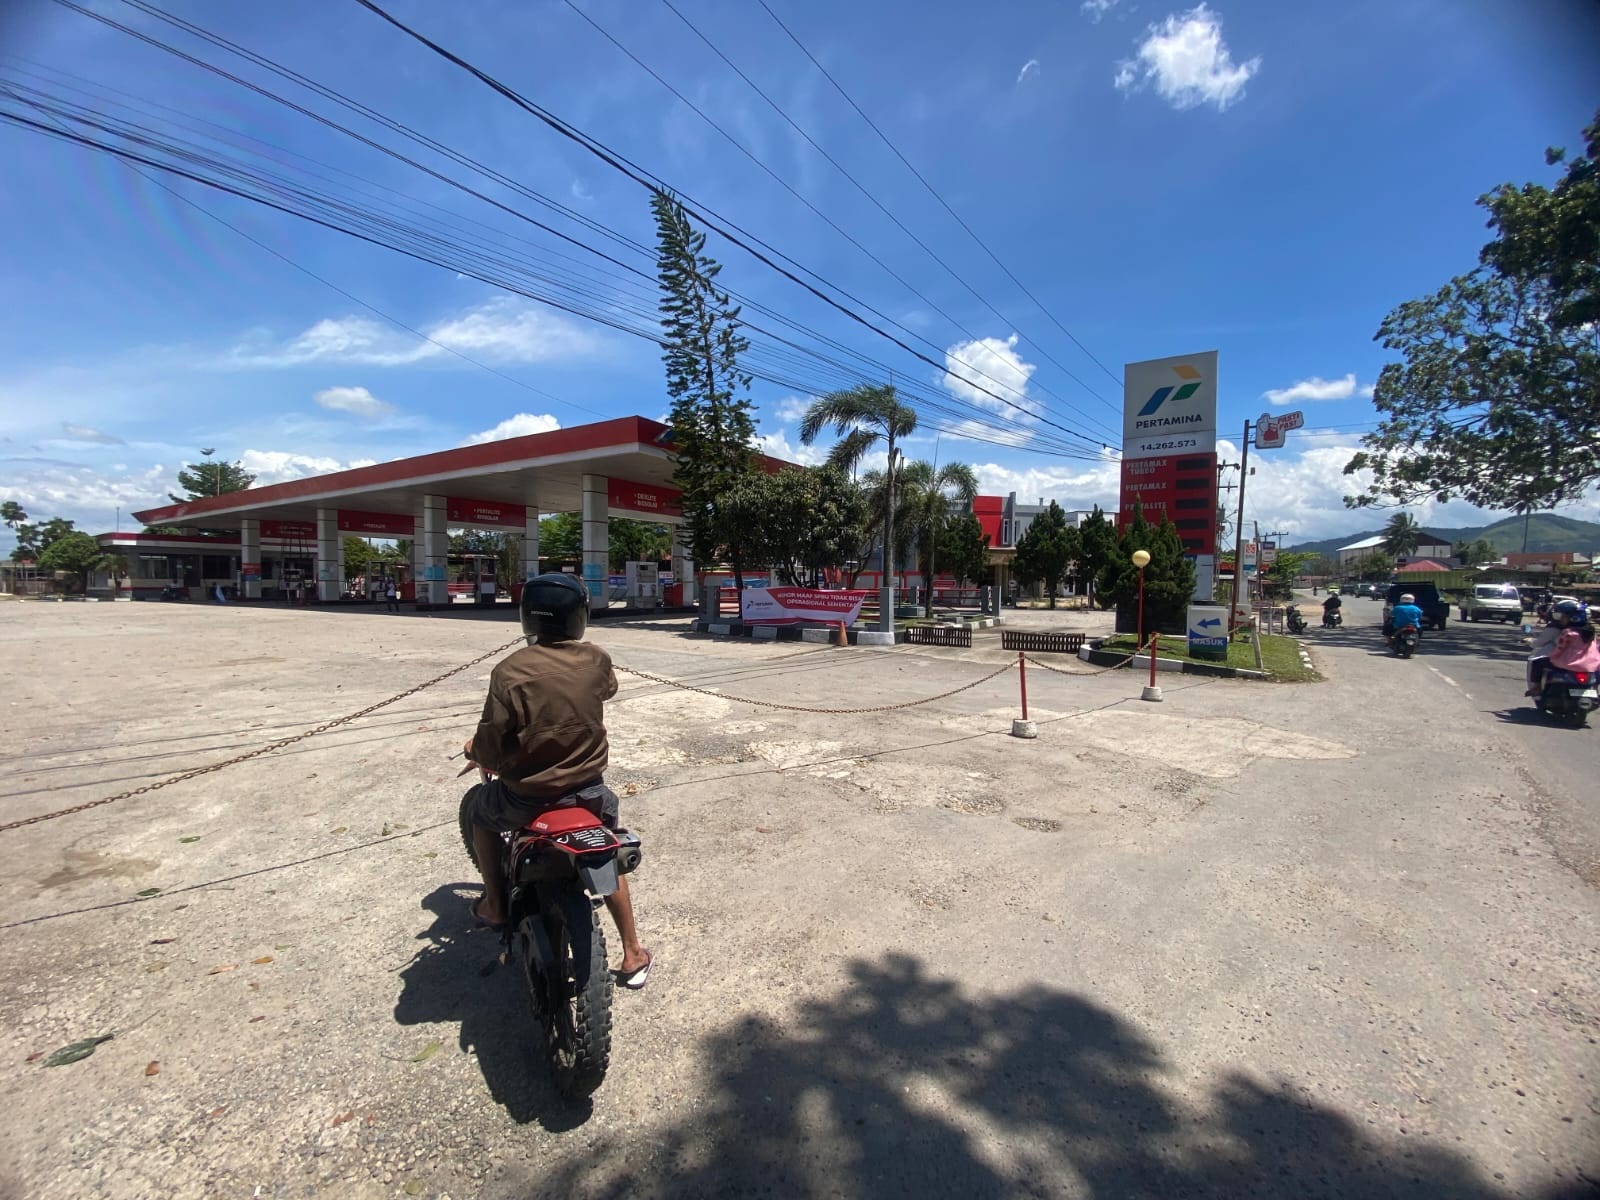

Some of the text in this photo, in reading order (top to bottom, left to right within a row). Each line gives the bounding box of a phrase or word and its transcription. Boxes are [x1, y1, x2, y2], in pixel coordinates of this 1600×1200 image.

[1136, 414, 1203, 429] PERTAMINA
[1141, 440, 1197, 452] 14.262.573
[1126, 460, 1168, 469] PERTAMAX
[1125, 481, 1167, 491] PERTAMAX
[1125, 501, 1167, 511] PETALITE
[1192, 638, 1224, 647] MASUK
